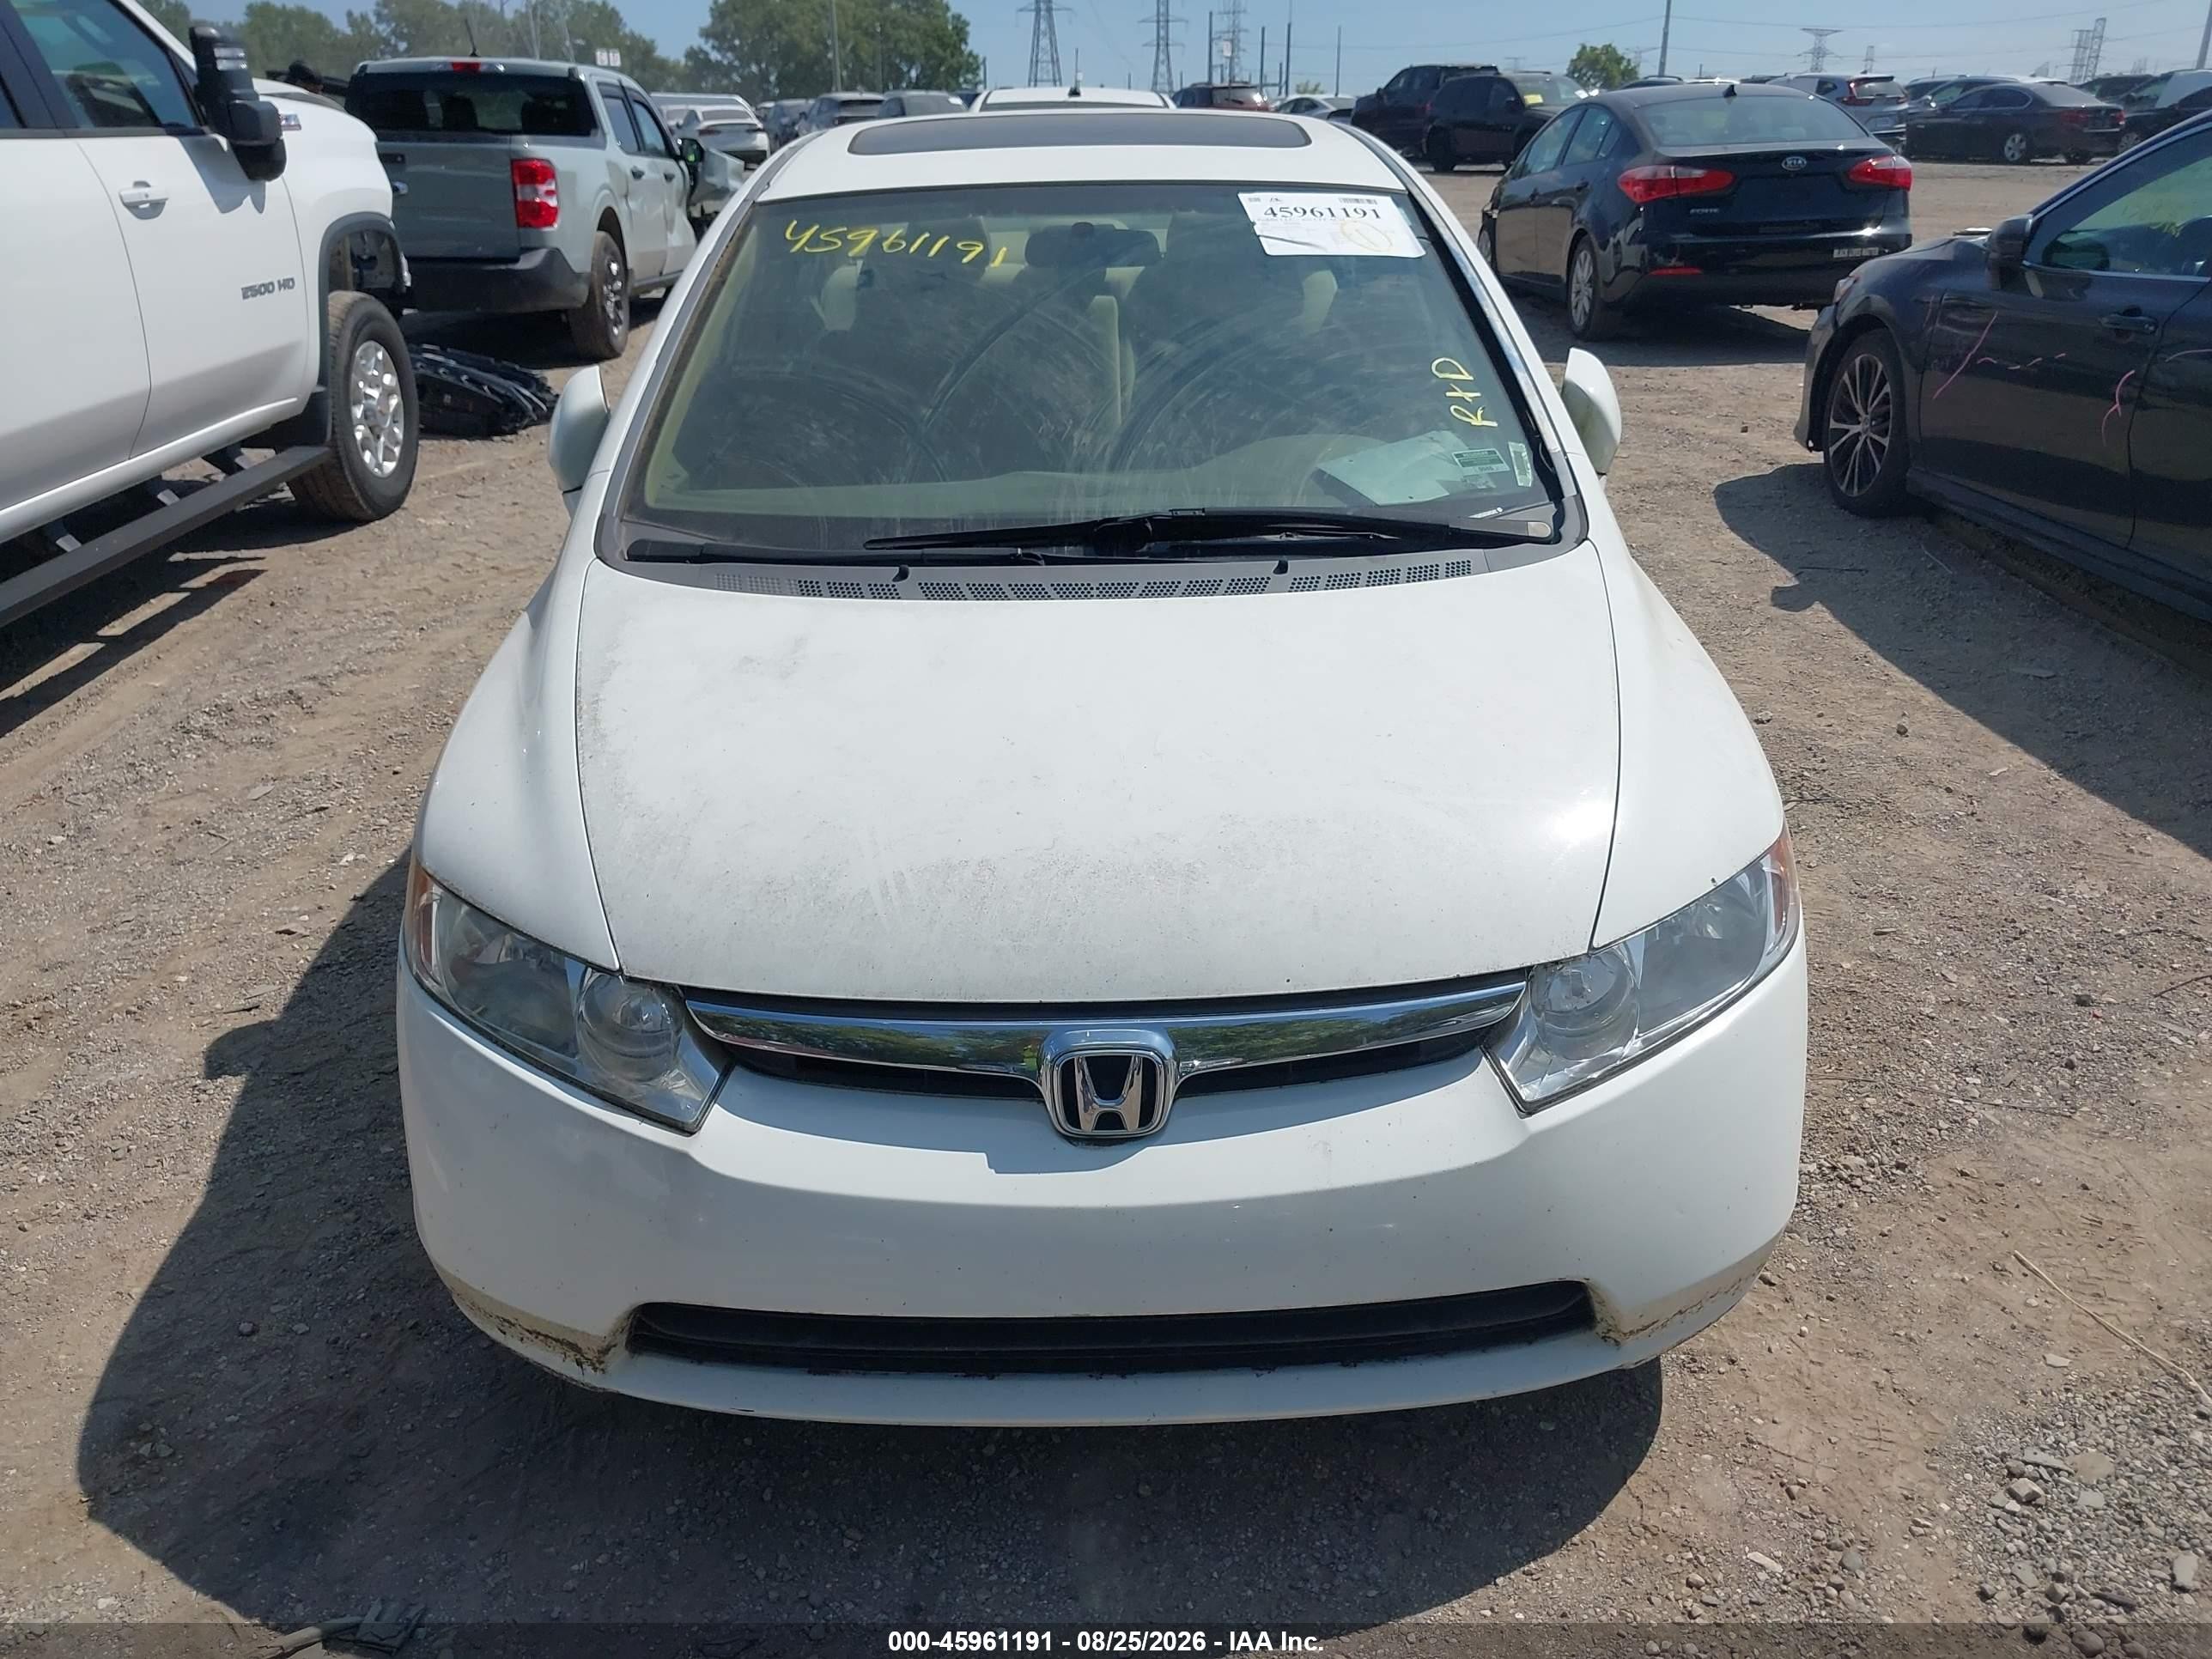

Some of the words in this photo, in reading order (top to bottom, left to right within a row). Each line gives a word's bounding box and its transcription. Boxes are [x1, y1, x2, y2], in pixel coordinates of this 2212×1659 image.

[1784, 157, 1804, 168] KIA
[1264, 206, 1382, 220] 45961191
[785, 220, 1008, 268] 45961191
[241, 281, 275, 300] 2500
[277, 277, 295, 291] HD
